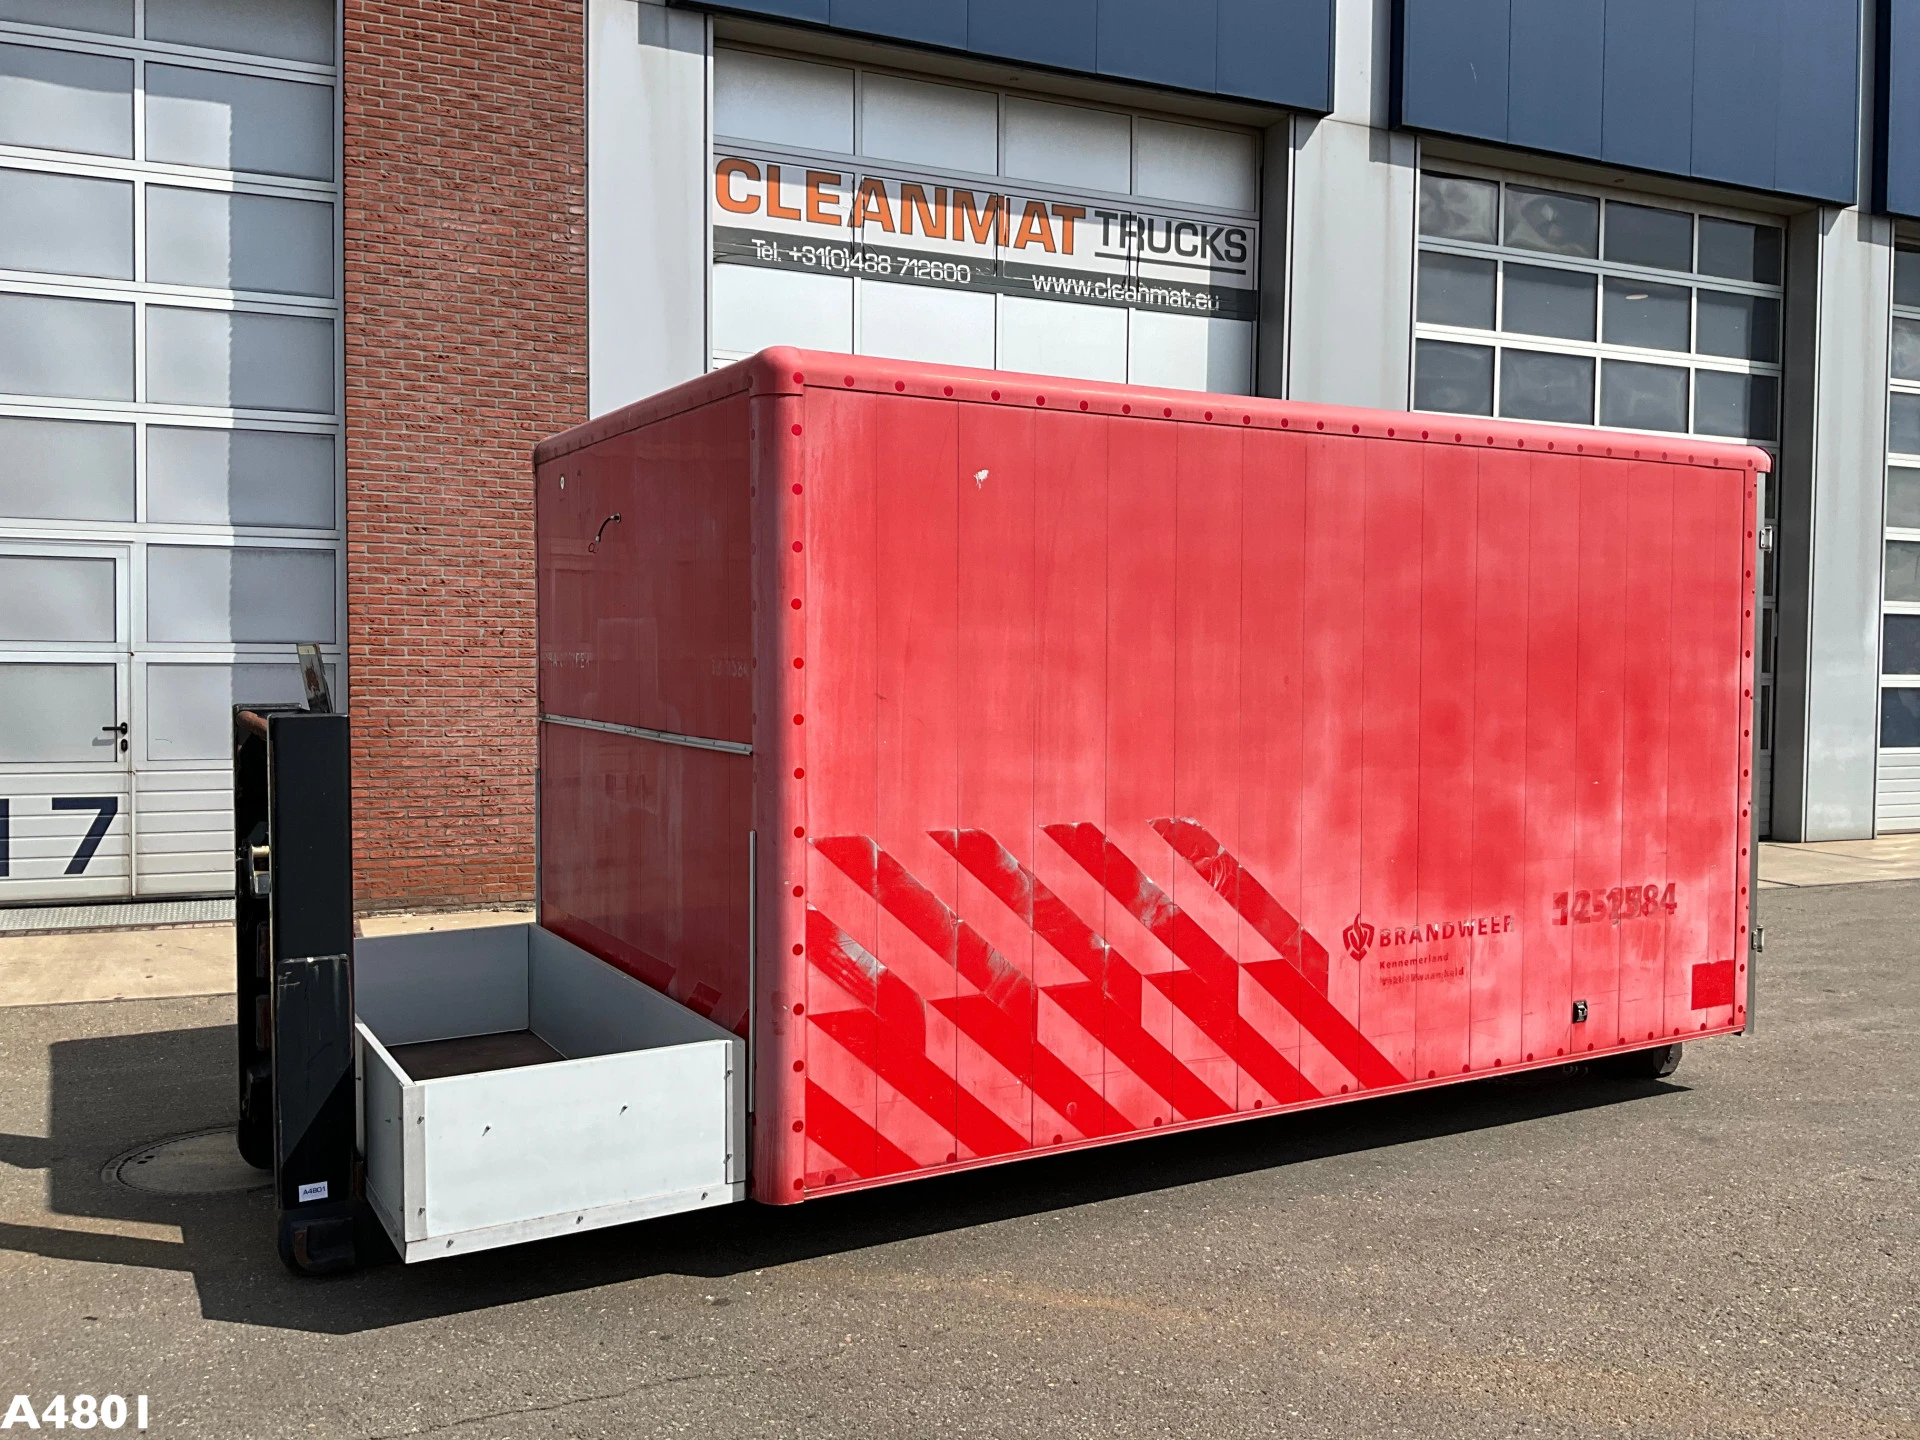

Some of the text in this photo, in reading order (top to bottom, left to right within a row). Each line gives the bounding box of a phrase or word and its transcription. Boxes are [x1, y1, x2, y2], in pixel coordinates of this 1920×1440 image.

[715, 157, 1247, 263] CLEANMAT TRUCKS
[752, 239, 782, 262] Tel.
[897, 256, 971, 283] 712600
[1031, 274, 1219, 311] www.cleanmat.eu
[1379, 952, 1449, 970] Kennemerland
[303, 1185, 327, 1196] A4801
